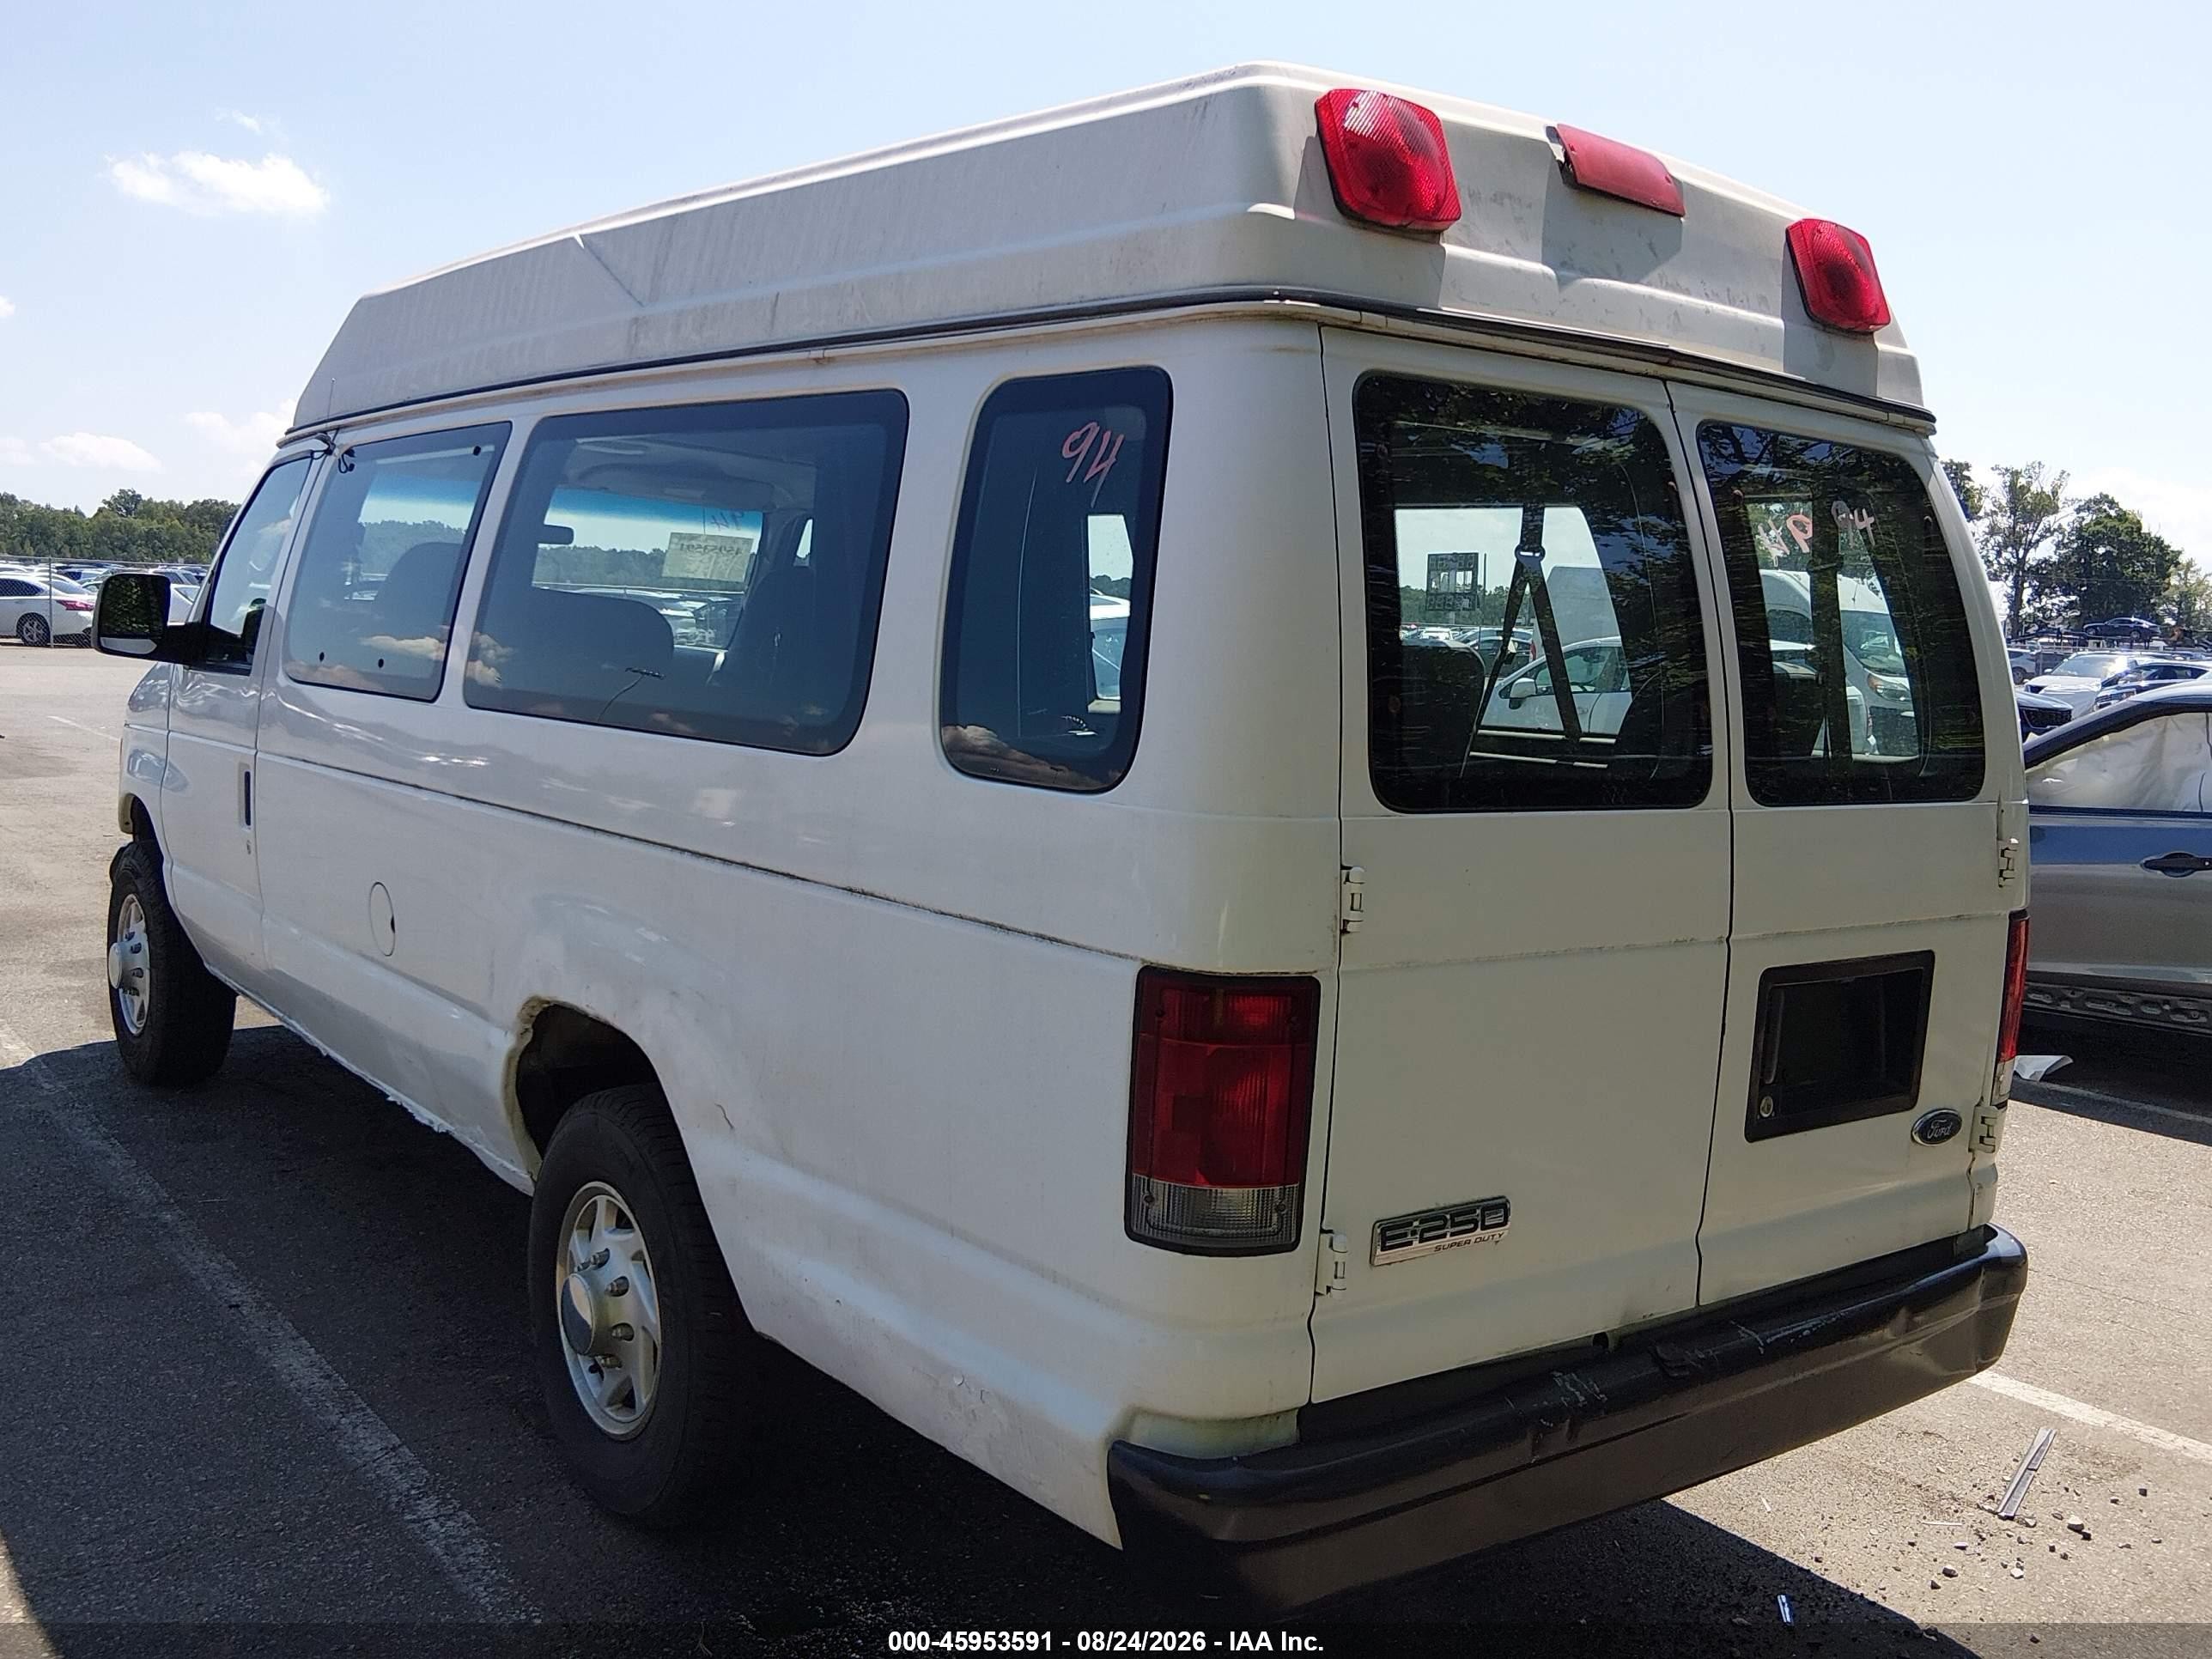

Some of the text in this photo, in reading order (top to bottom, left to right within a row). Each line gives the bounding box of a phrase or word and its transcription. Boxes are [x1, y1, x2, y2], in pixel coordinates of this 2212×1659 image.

[1061, 421, 1124, 508] 94
[1832, 500, 1875, 548] 94
[1927, 1119, 1953, 1139] Ford
[1433, 1232, 1505, 1253] SUPER DUTY
